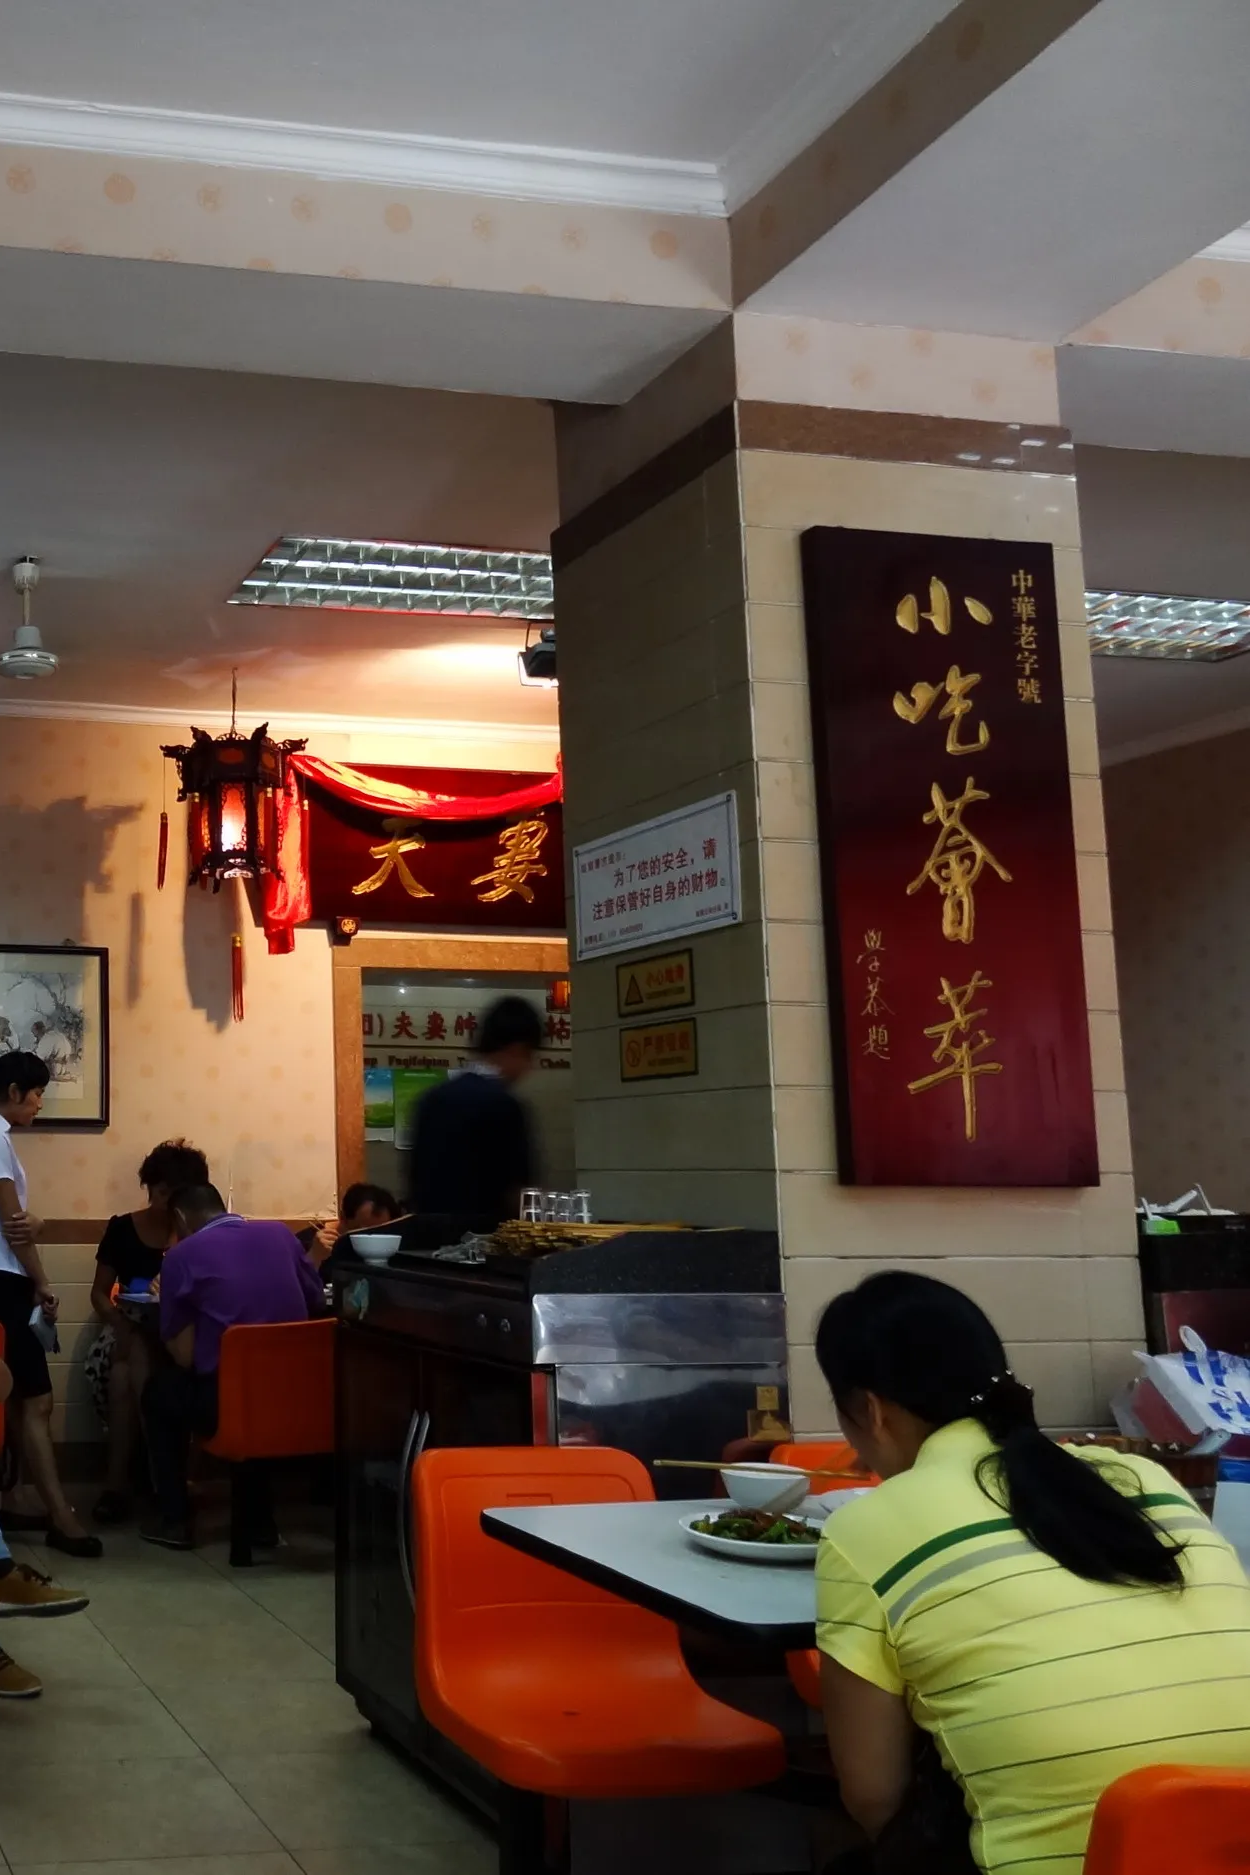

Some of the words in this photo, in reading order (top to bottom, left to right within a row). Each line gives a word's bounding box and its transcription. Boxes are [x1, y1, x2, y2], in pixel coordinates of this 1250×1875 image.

[1010, 568, 1042, 704] 中華老字號
